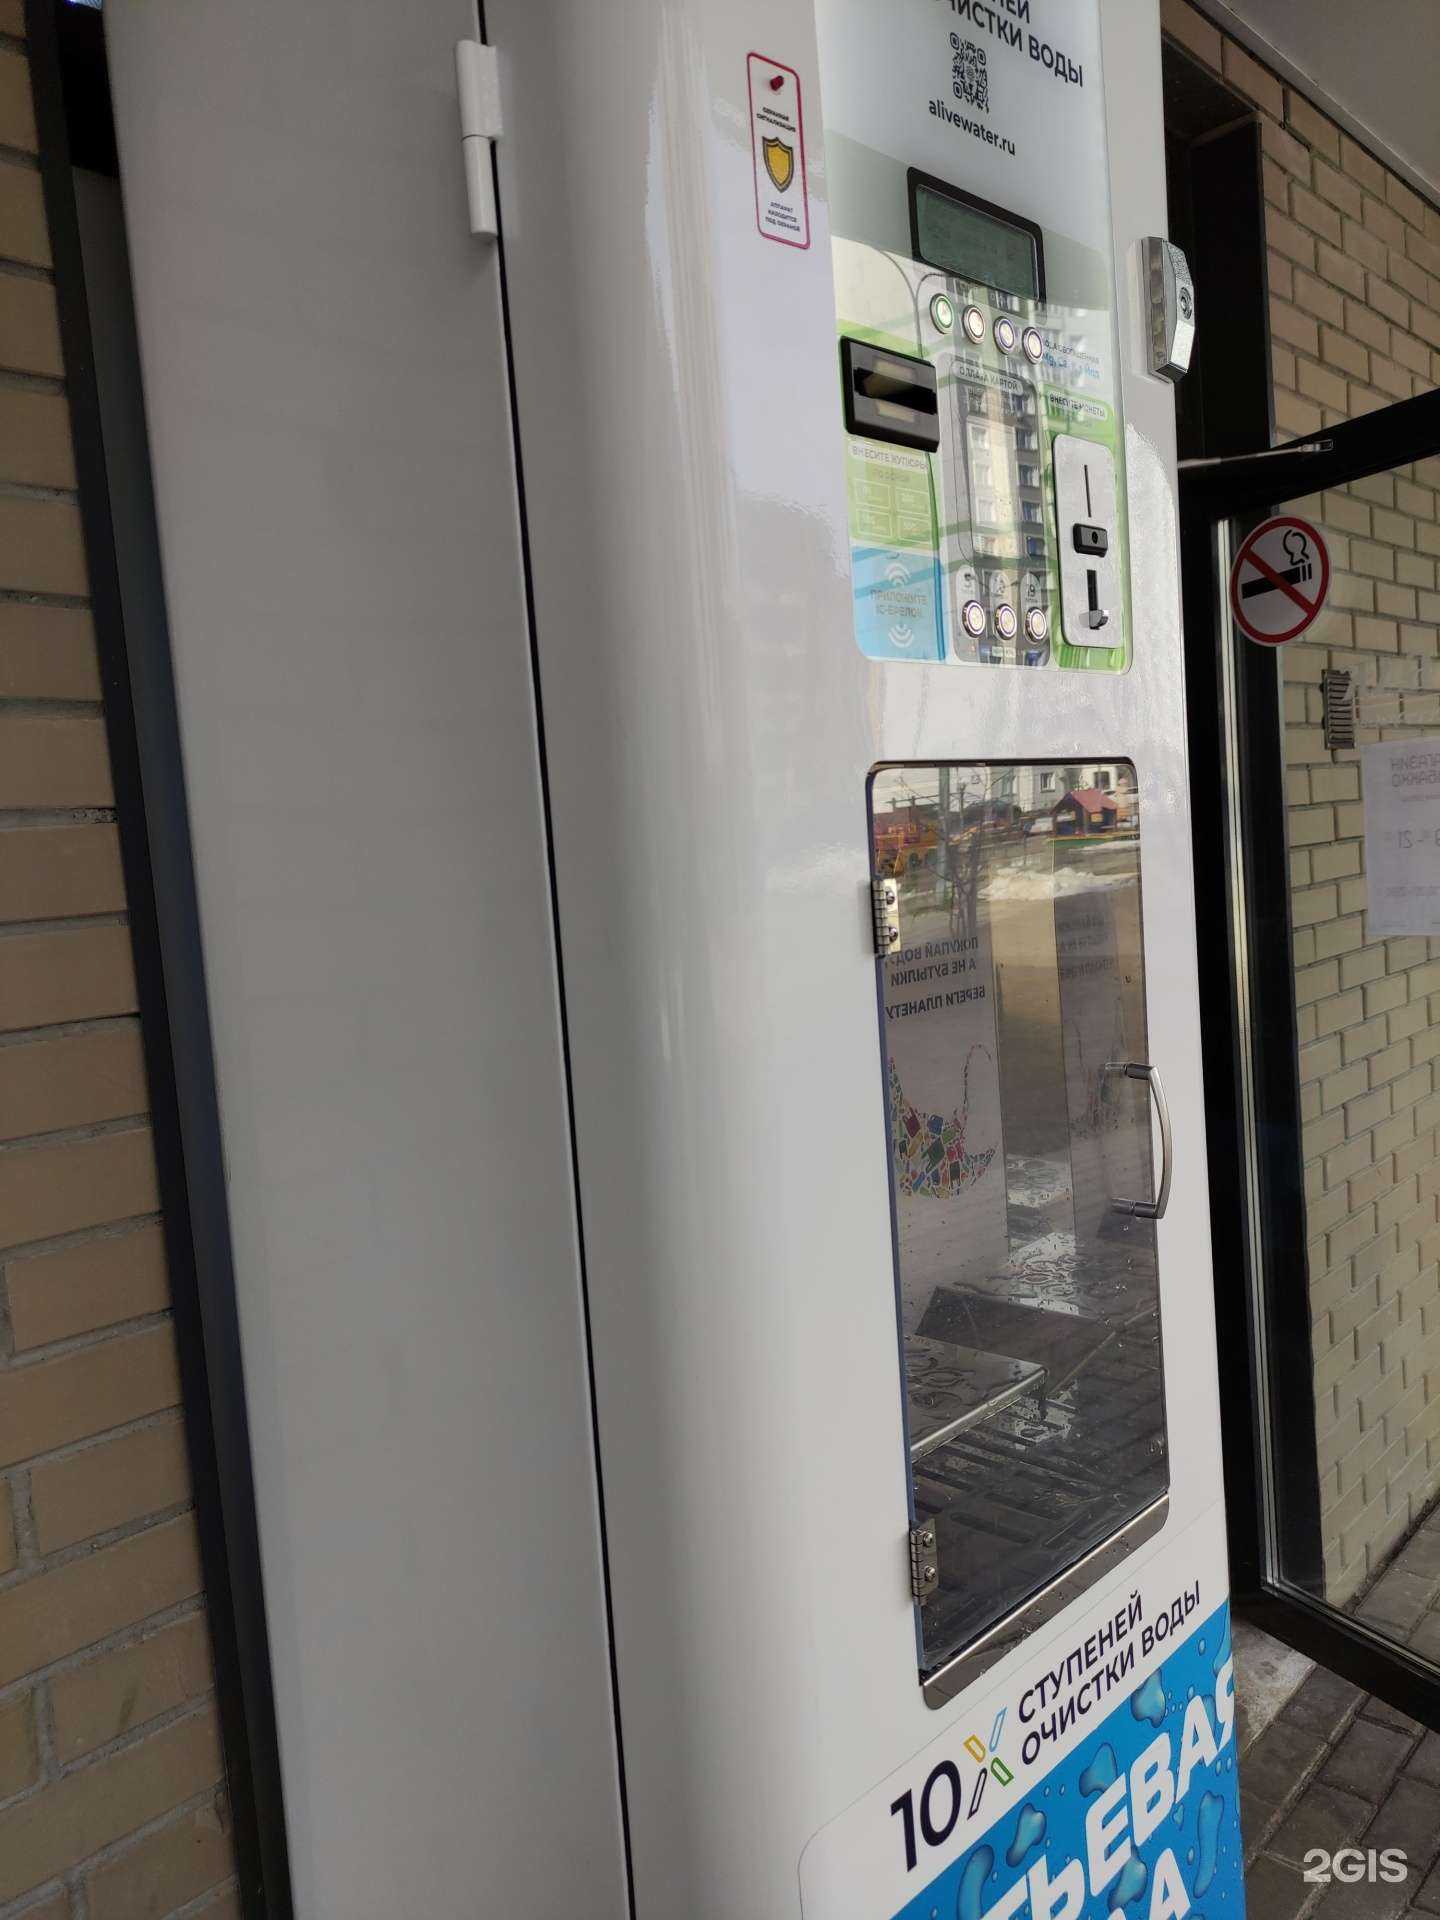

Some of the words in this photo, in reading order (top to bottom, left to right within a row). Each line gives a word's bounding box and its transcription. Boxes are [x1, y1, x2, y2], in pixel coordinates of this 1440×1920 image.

[1028, 34, 1083, 87] ВОДЫ
[928, 99, 1016, 156] alivewater.ru
[852, 445, 889, 463] ВНЕСИТЕ
[1021, 1644, 1135, 1765] ОЧИСТКИ
[1142, 1580, 1201, 1658] ВОДЫ
[890, 1760, 962, 1873] 10
[1018, 1589, 1144, 1724] СТУПЕНЕЙ
